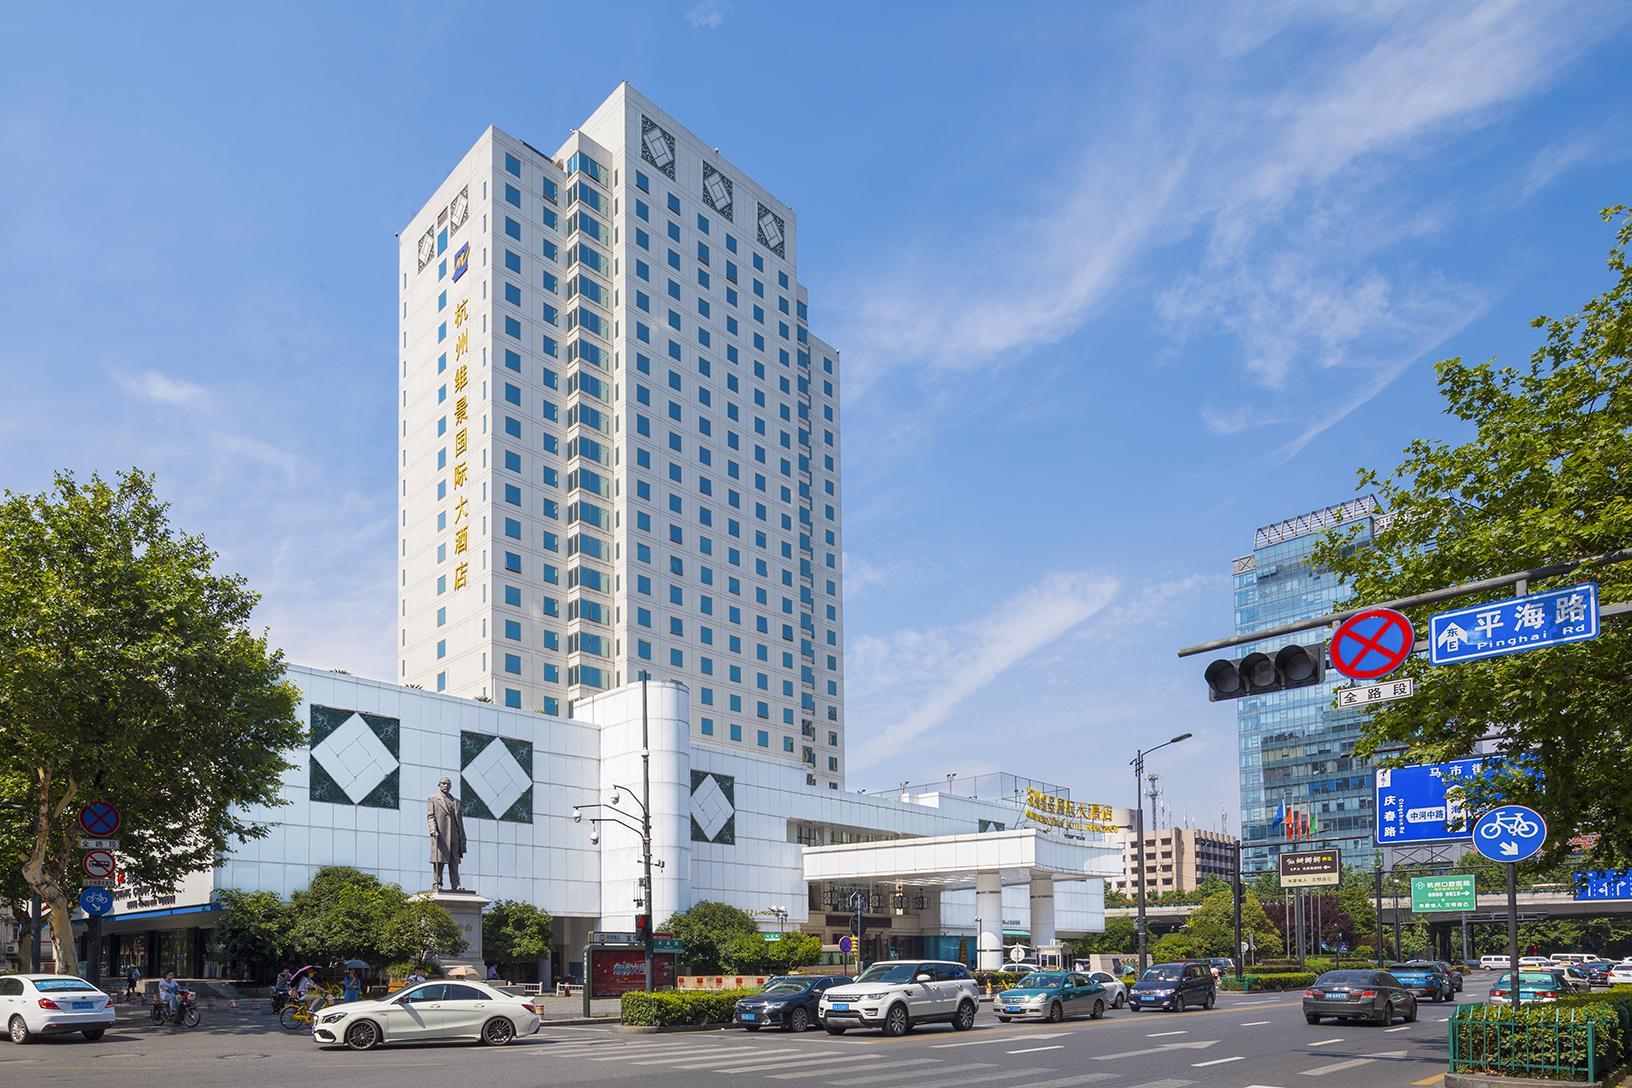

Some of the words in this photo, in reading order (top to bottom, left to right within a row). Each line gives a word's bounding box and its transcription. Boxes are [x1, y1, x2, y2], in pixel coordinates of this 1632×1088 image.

[454, 298, 469, 592] 杭州维景国际大酒店
[1474, 593, 1588, 639] 平海路
[1447, 627, 1459, 638] 东
[1476, 630, 1548, 650] Pinghai
[1562, 623, 1586, 635] Rd
[1449, 640, 1457, 650] E
[1344, 683, 1407, 704] 全路段
[1383, 795, 1397, 838] 庆春路
[1410, 809, 1444, 820] 中河中路
[82, 840, 117, 849] 全路段
